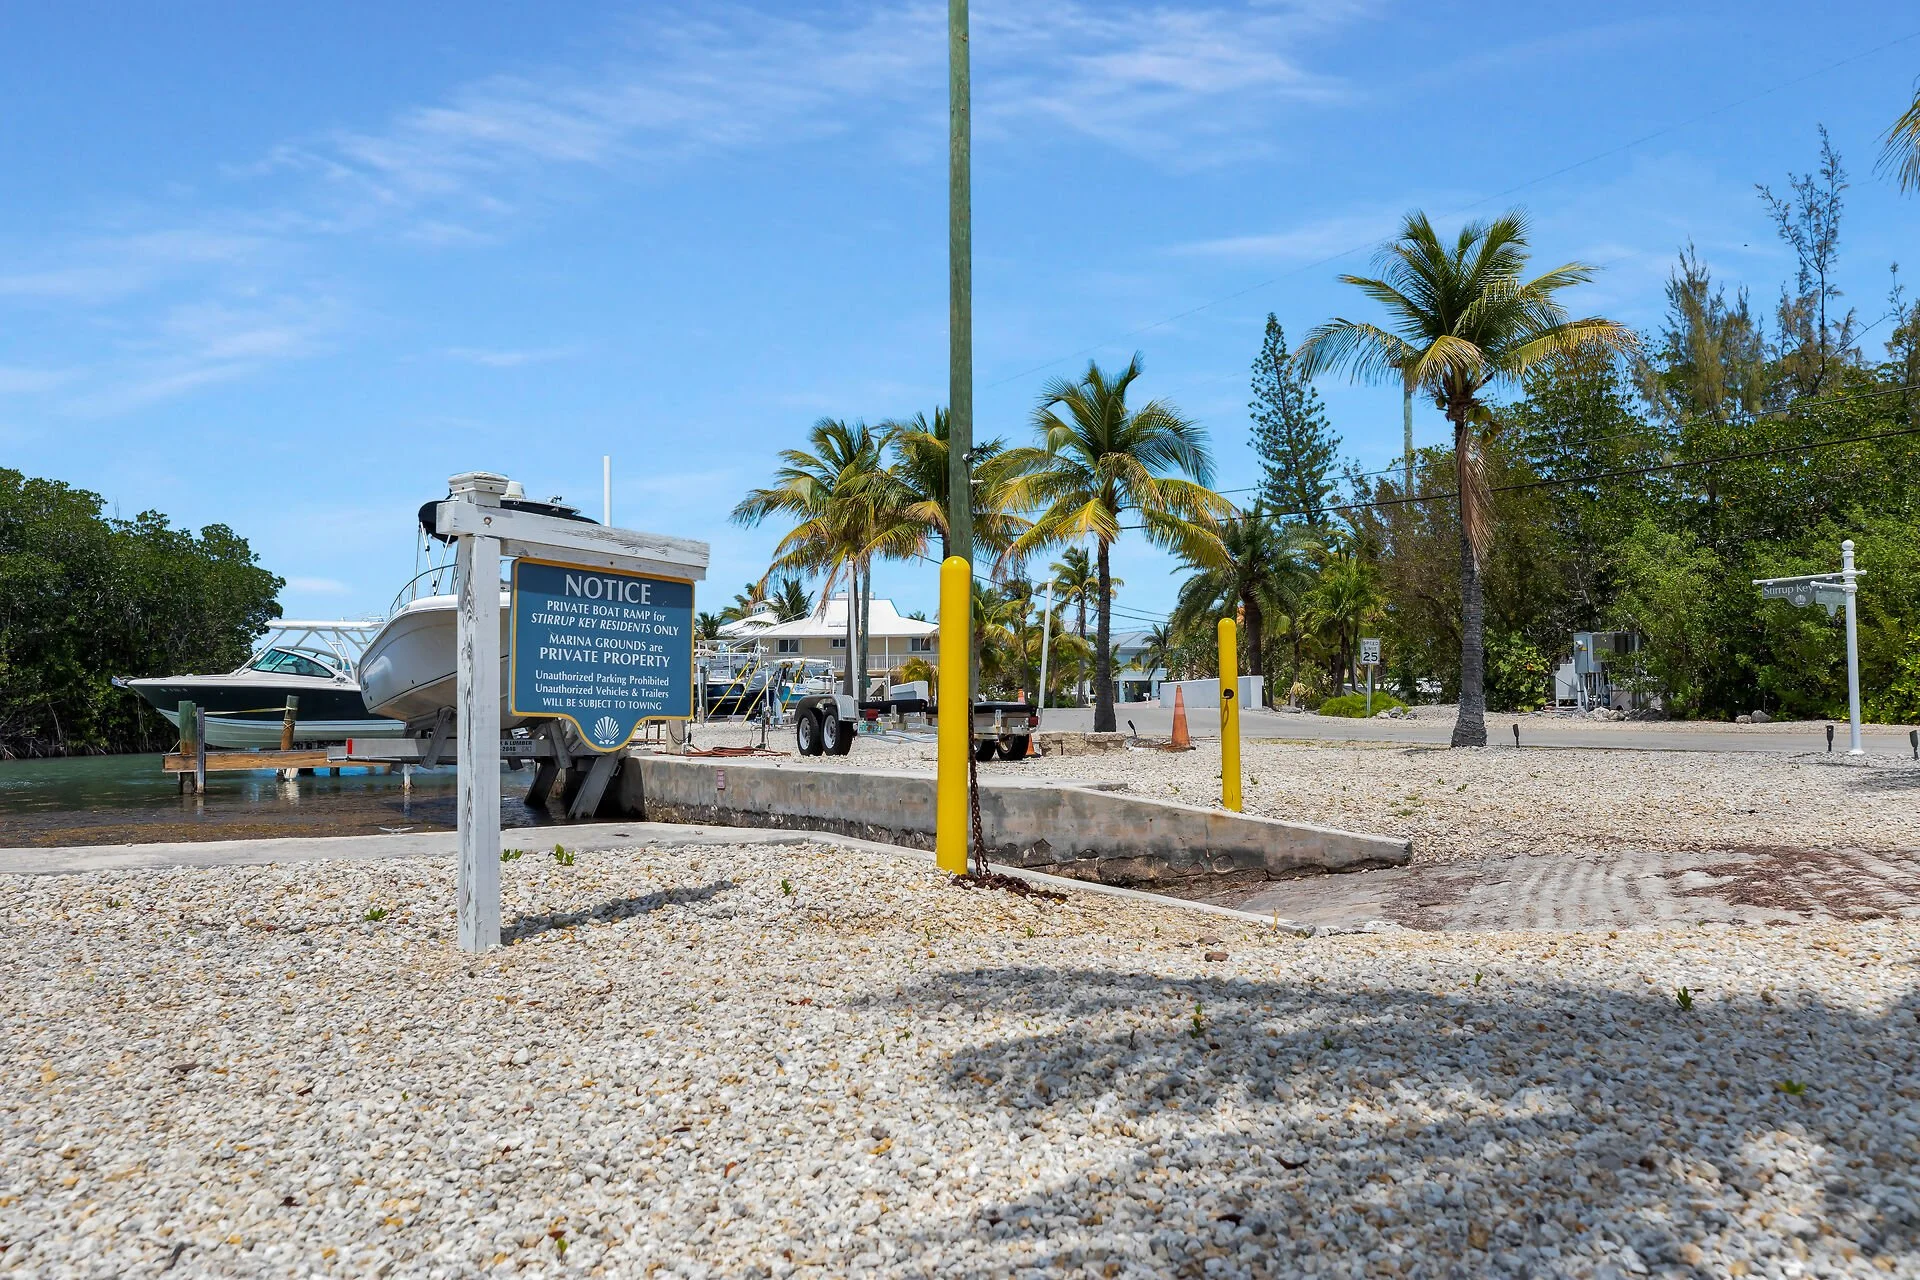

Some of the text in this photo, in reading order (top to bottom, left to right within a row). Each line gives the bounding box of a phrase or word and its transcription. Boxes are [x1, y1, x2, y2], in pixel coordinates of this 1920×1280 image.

[566, 574, 651, 605] NOTICE
[1764, 583, 1812, 596] Stirrup Key
[547, 600, 666, 622] PRIVATE BOAT RAMP for
[531, 613, 679, 636] STIRRUP KEY RESIDENTS ONLY
[549, 634, 663, 653] MARINA GROUNDS are
[540, 647, 670, 668] PRIVATE PROPERTY
[1363, 652, 1378, 661] 25
[536, 670, 669, 686] Unauthorized Parking Prohibited
[536, 684, 669, 698] Unauthorized Vehicles & Trailers
[543, 698, 662, 710] WILL BE SUBJECT TO TOWING
